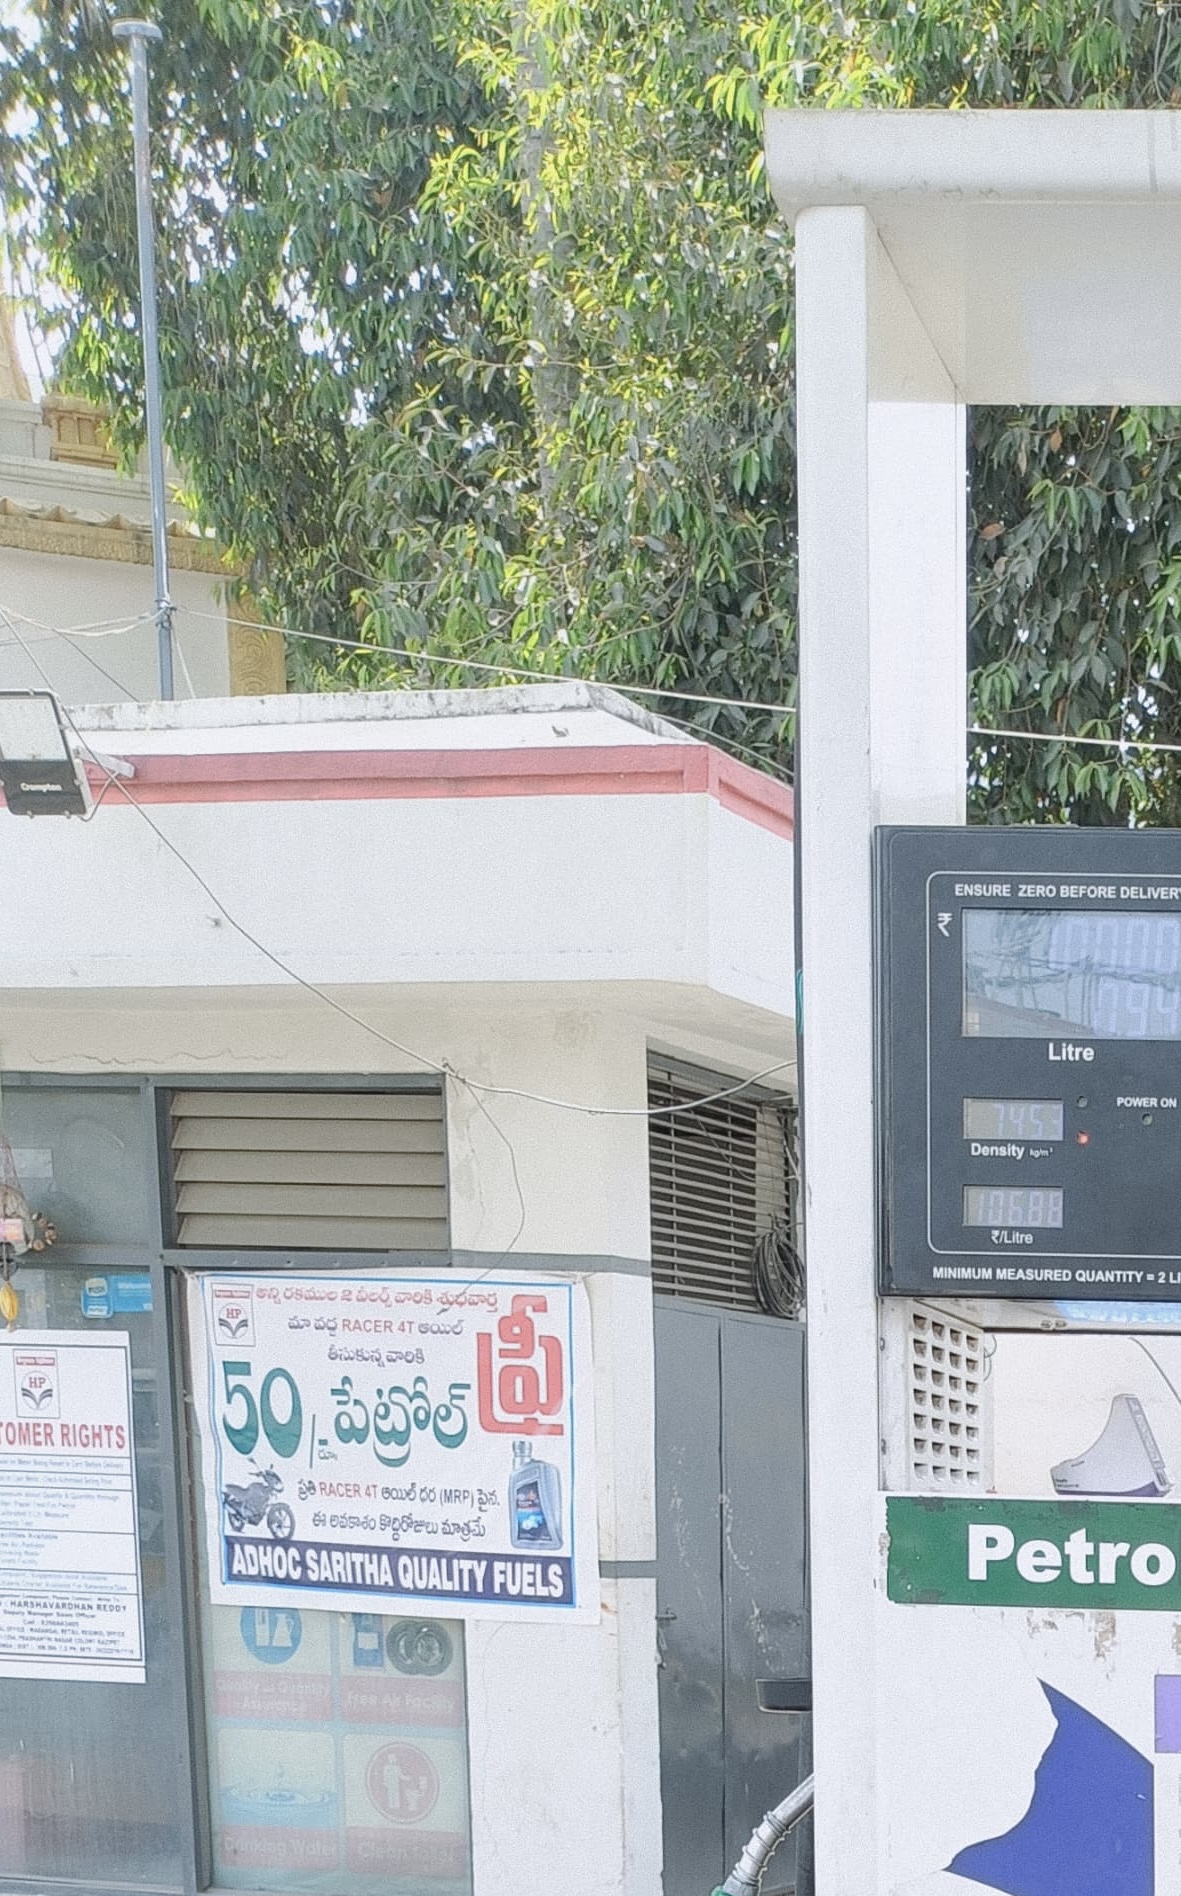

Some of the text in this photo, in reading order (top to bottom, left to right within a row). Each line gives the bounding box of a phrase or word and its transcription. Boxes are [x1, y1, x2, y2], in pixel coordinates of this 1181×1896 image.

[955, 884, 1011, 898] ENSURE
[1018, 885, 1057, 899] ZERO
[1060, 886, 1117, 900] BEFORE
[937, 912, 953, 937] ₹
[1048, 1042, 1095, 1062] Litre
[1116, 1097, 1177, 1108] POWER ON
[971, 1143, 1025, 1160] Density
[991, 1230, 1034, 1245] ₹/Litre
[933, 1266, 993, 1280] MINIMUM
[996, 1268, 1072, 1282] MEASURED
[1075, 1269, 1144, 1284] QUANTITY
[1158, 1271, 1167, 1284] 2
[226, 1308, 241, 1319] HP
[342, 1318, 393, 1334] RACER
[399, 1320, 414, 1334] 4T
[29, 1377, 46, 1388] HP
[60, 1423, 125, 1449] RIGHTS
[319, 1481, 361, 1498] RACER
[365, 1485, 378, 1498] 4T
[440, 1489, 474, 1508] (MRP)
[232, 1544, 563, 1597] ADHOC SARITHA QUALITY FUELS
